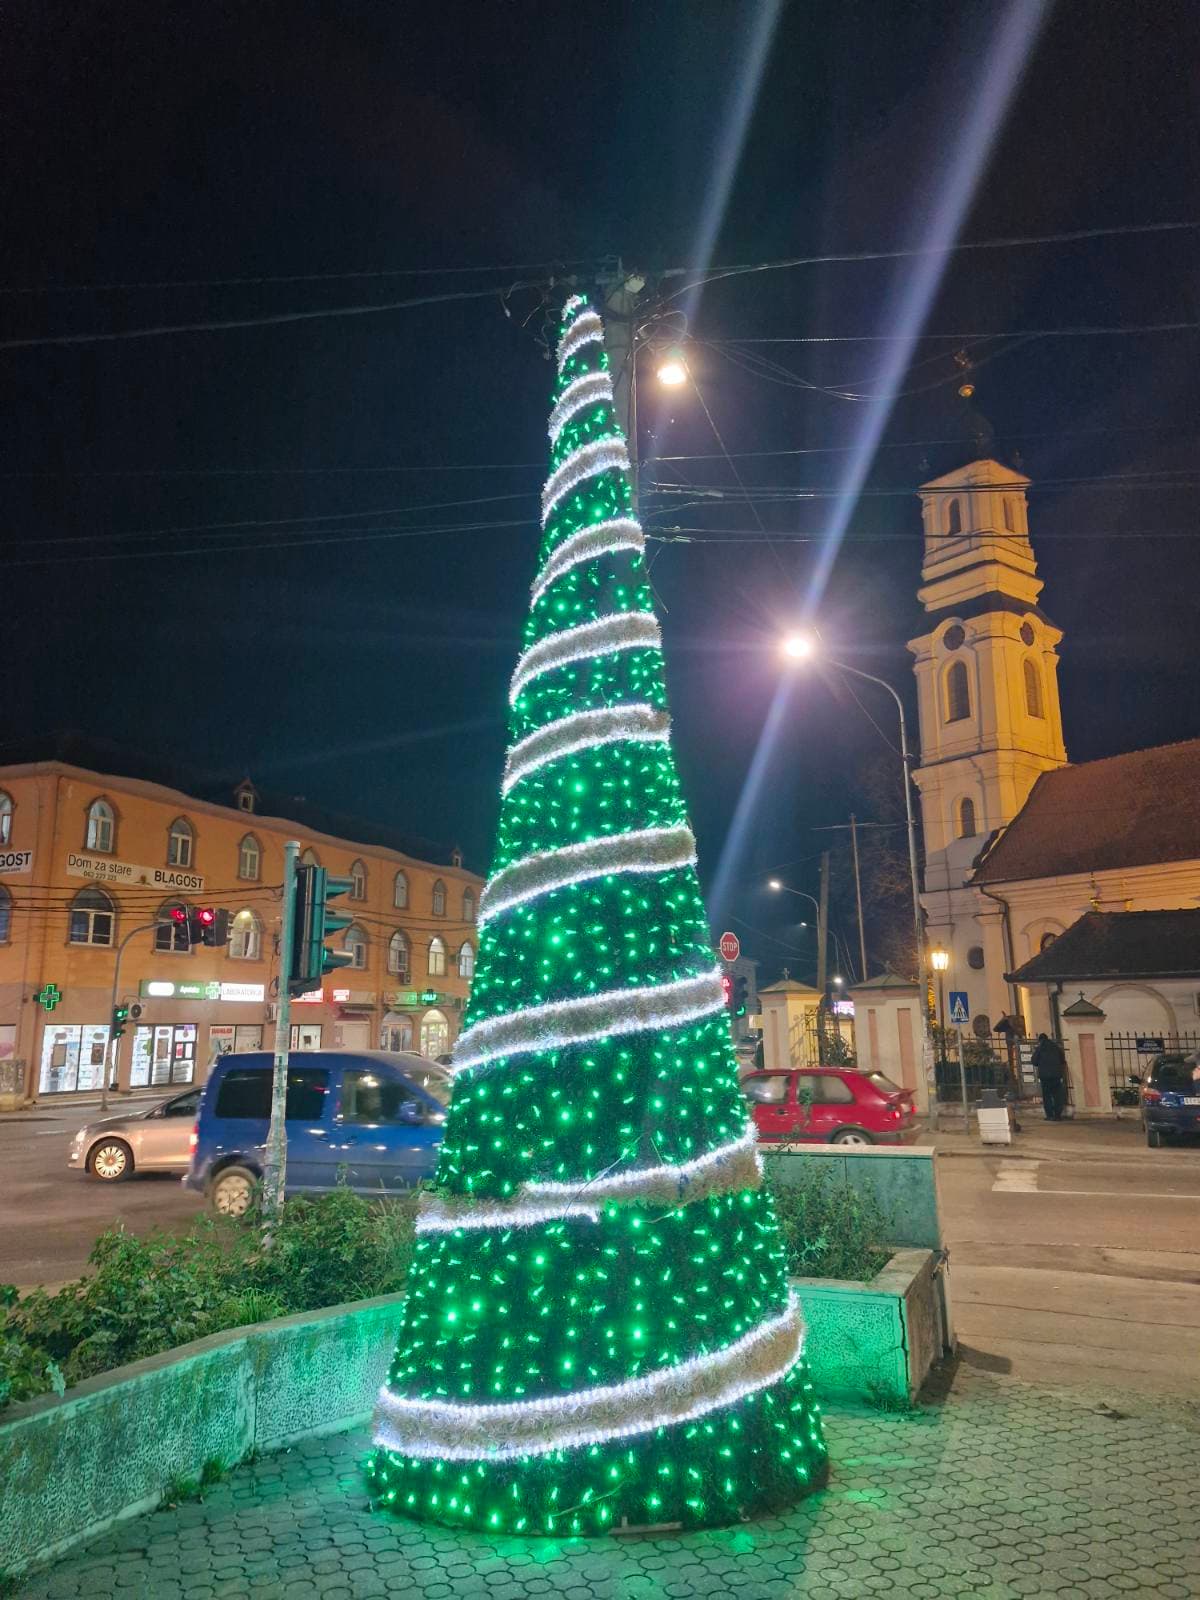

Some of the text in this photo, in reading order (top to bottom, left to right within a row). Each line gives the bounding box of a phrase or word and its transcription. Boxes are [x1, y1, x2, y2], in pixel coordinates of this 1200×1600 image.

[68, 854, 132, 876] Dom za stare
[154, 870, 204, 889] BLAGOST
[722, 942, 738, 952] STOP
